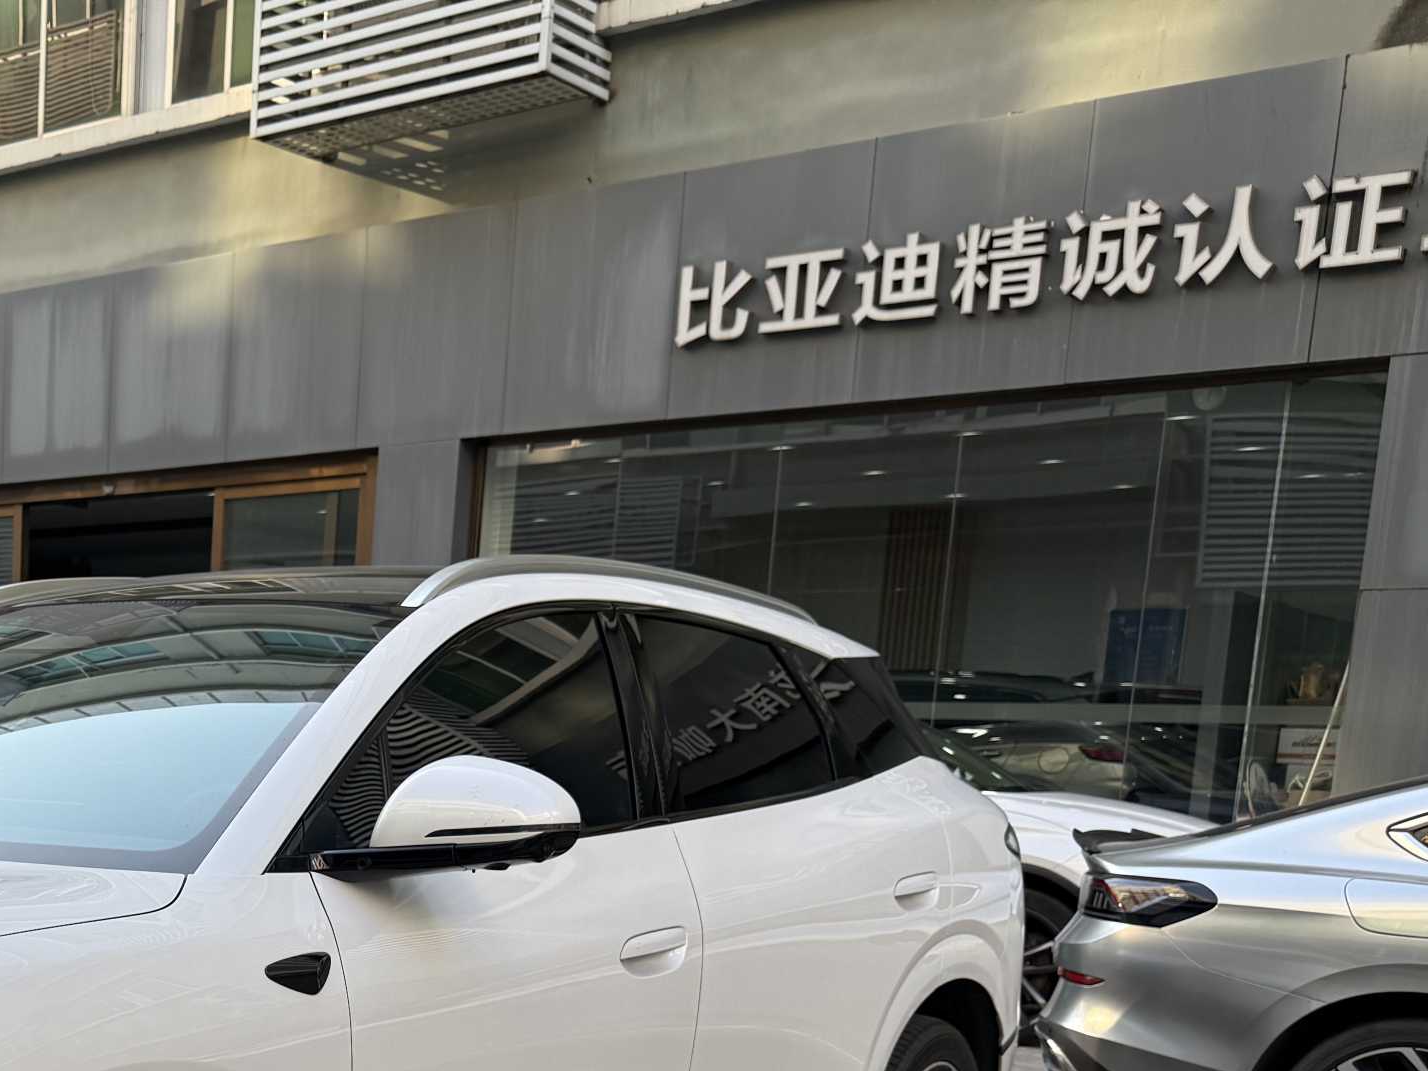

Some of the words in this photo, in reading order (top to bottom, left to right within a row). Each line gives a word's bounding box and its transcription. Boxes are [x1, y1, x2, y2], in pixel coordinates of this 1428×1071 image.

[674, 170, 1428, 350] 比亚迪精诚认证
